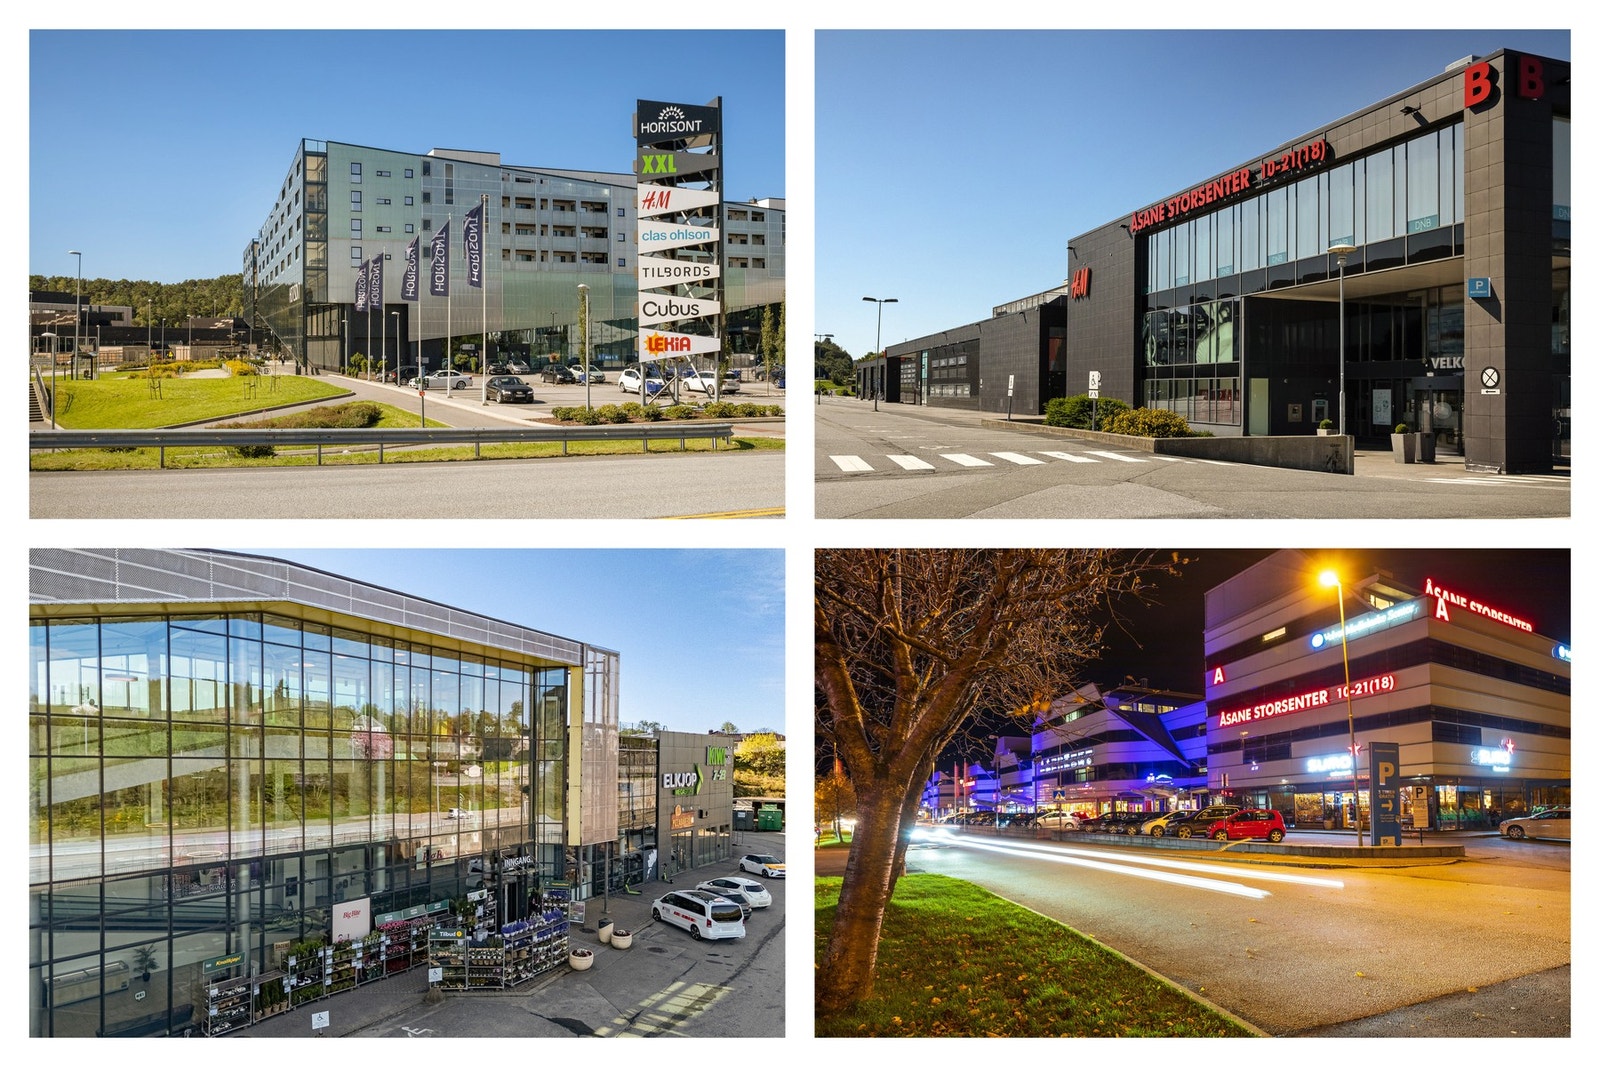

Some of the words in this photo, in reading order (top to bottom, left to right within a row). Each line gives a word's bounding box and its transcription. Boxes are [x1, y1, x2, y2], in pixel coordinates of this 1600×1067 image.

[1464, 61, 1491, 109] B
[1518, 56, 1544, 99] B
[641, 120, 702, 133] HORISONT
[642, 154, 677, 174] XXL
[1130, 206, 1165, 233] ÅSANE
[1167, 168, 1250, 218] STORSENTER
[1260, 139, 1326, 179] 10-21(18)
[642, 190, 671, 210] H&M
[1415, 218, 1432, 231] DNB
[642, 230, 666, 241] clas
[670, 229, 710, 241] ohlson
[642, 266, 711, 278] TILBORDS
[1475, 280, 1484, 290] P
[642, 299, 700, 317] Cubus
[1435, 597, 1450, 622] A
[1213, 667, 1225, 685] A
[1219, 710, 1252, 727] ÅSANE
[1253, 690, 1329, 719] STORSENTER
[1336, 675, 1395, 699] 10-21(18)
[1379, 762, 1395, 785] P
[1416, 787, 1424, 798] P
[504, 855, 531, 868] INNGANG
[343, 910, 352, 920] Big
